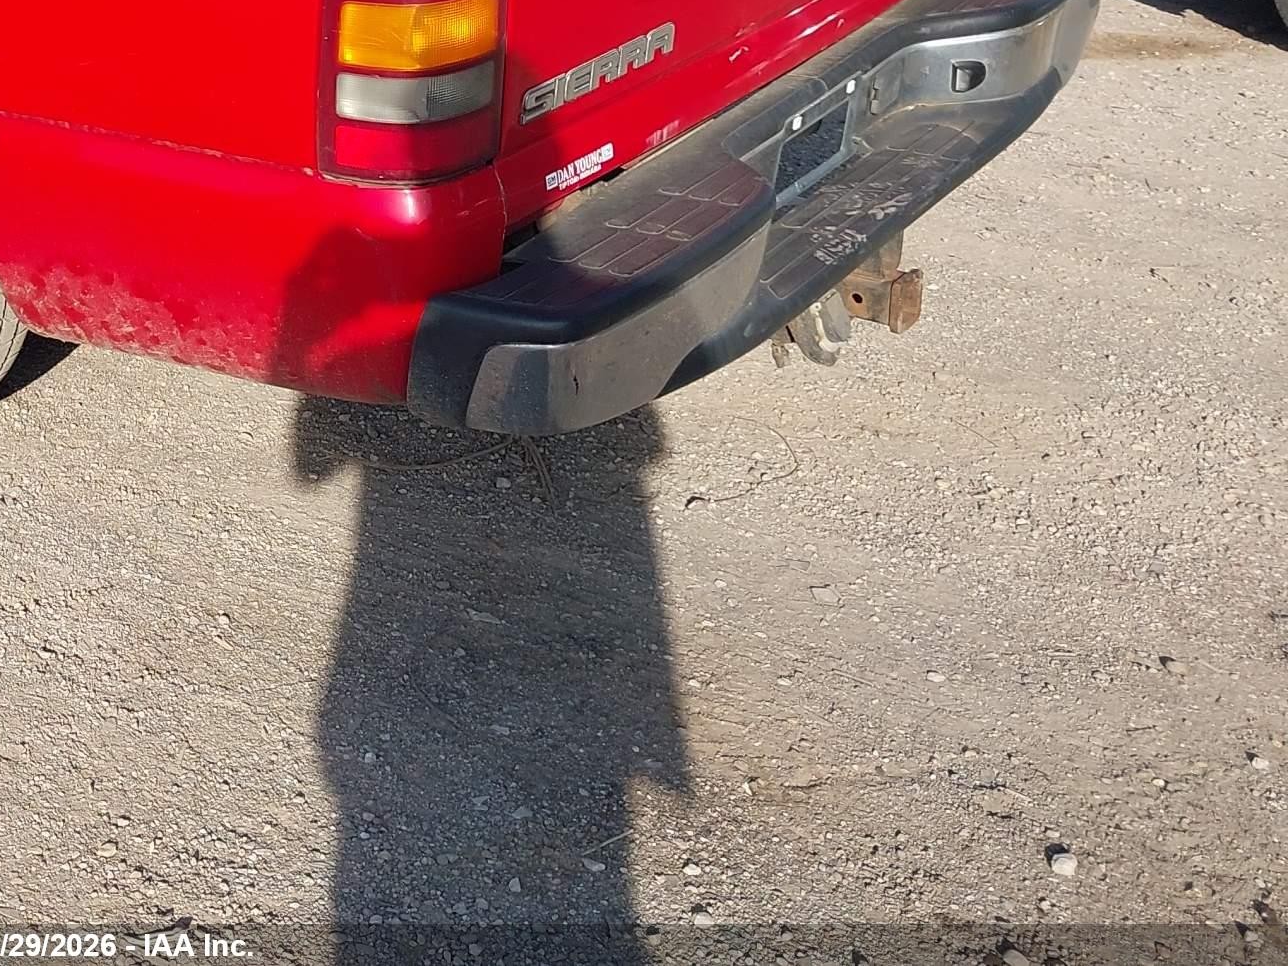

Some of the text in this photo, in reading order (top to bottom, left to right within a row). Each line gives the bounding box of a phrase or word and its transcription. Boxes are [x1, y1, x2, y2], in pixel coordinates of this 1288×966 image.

[520, 21, 675, 125] SIERRA
[557, 162, 575, 184] DAN
[574, 148, 603, 174] YOUNG
